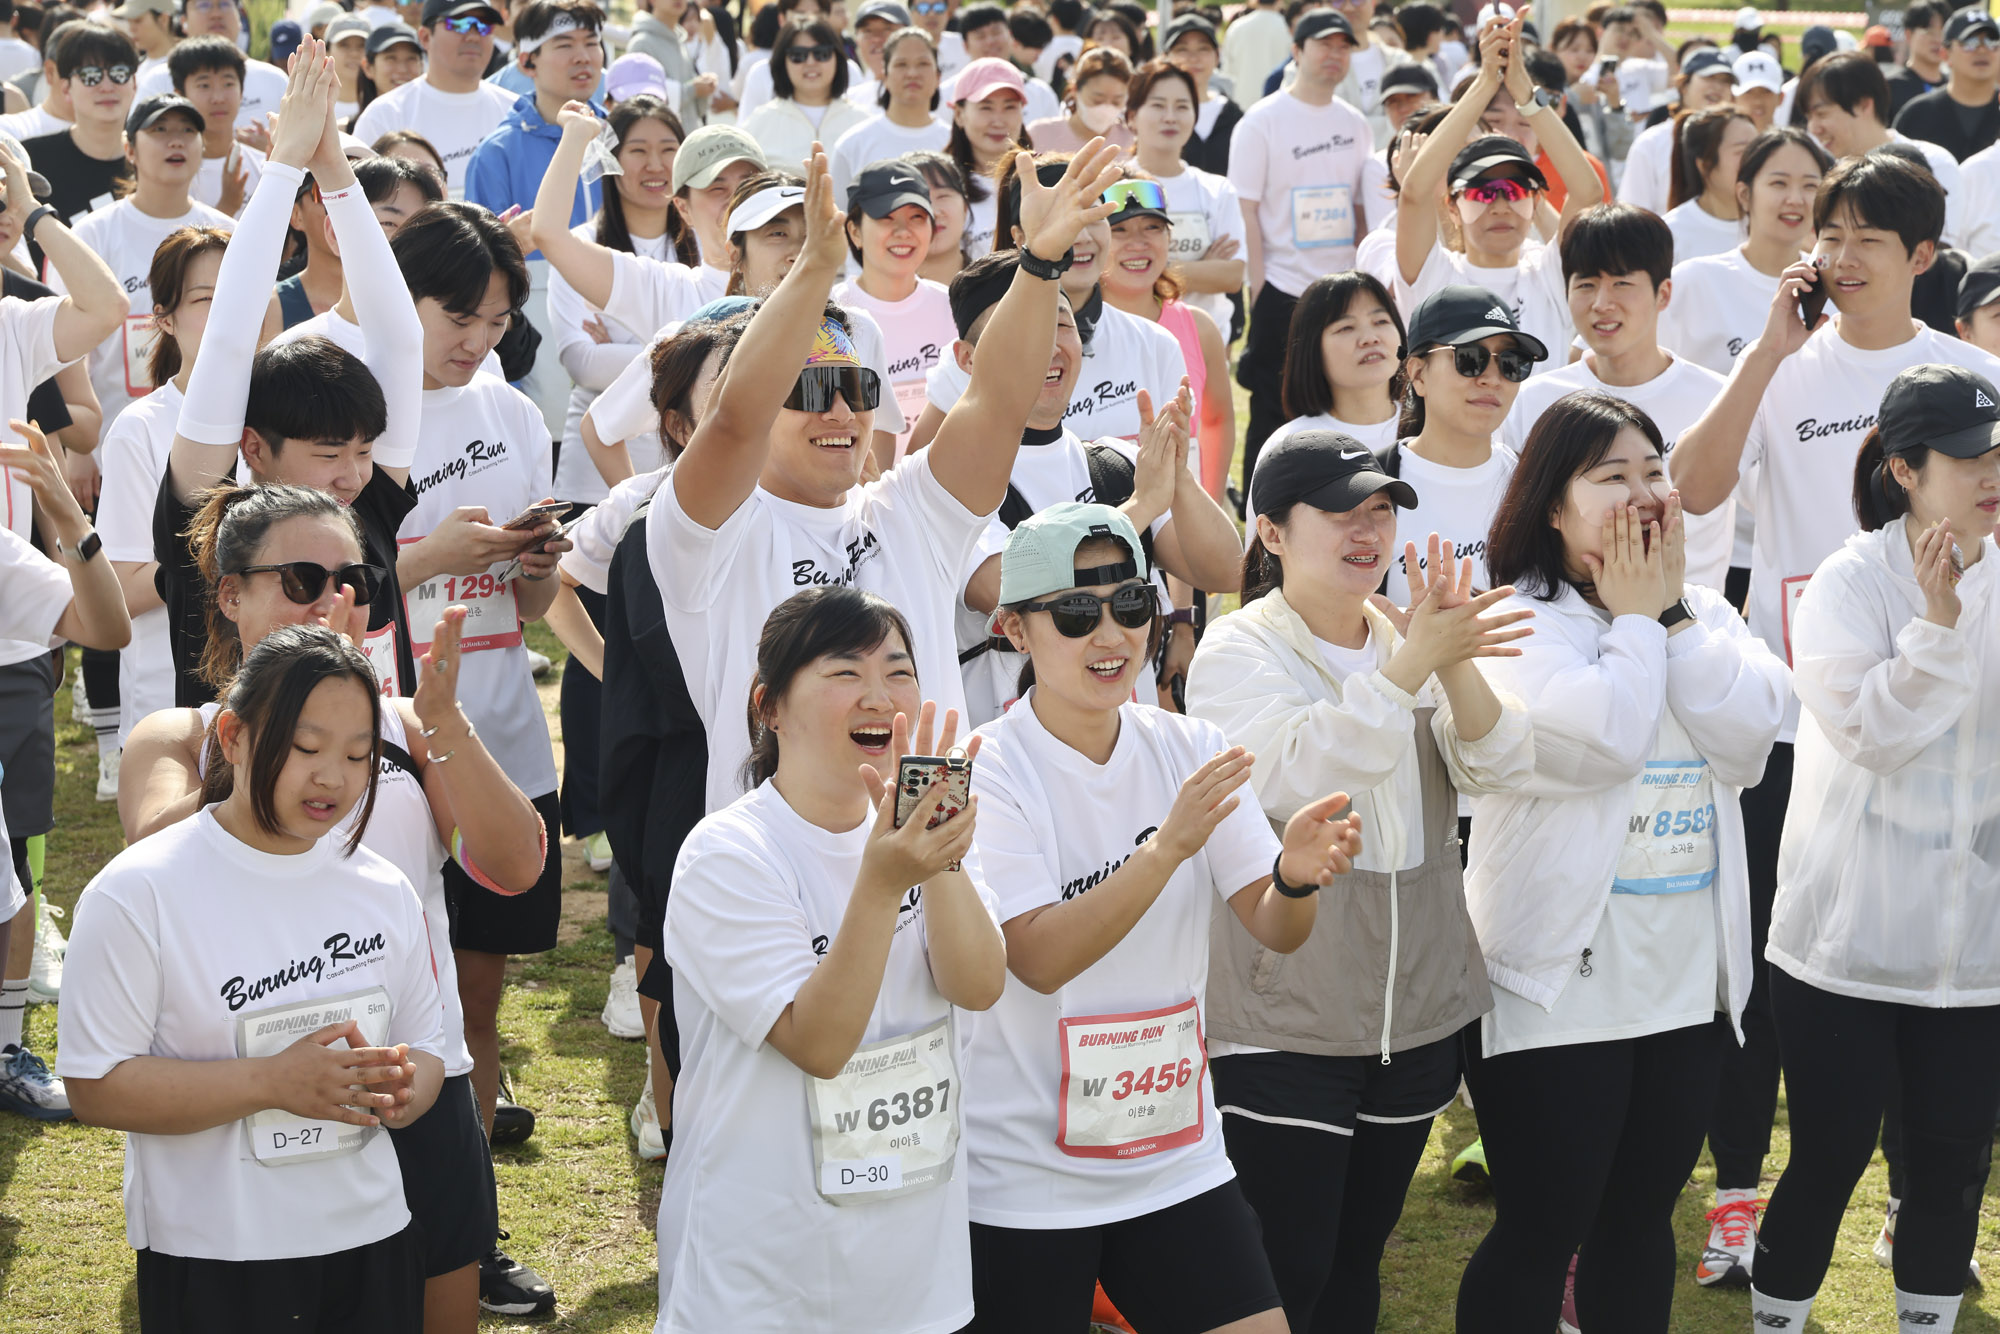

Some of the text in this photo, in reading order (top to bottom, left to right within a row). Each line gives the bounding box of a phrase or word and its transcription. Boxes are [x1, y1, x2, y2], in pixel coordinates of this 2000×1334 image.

[1484, 314, 1511, 325] adidas
[135, 347, 148, 359] W
[1061, 381, 1136, 419] ing Run
[1795, 413, 1880, 442] Burnin
[465, 439, 506, 467] Run
[418, 573, 506, 602] M 1294
[1628, 815, 1651, 833] W
[220, 932, 386, 1012] Burning Run
[325, 954, 386, 981] Casual Running Festival
[367, 1002, 386, 1015] 5km
[255, 1007, 352, 1037] BURNING RUN
[1177, 1018, 1195, 1033] 10km
[928, 1036, 944, 1051] 5km
[1078, 1024, 1166, 1047] BURNING RUN
[1127, 1040, 1146, 1048] Running
[891, 1046, 917, 1065] RUN
[860, 1059, 917, 1078] Casual Running Festival
[1083, 1057, 1192, 1101] W 3456
[834, 1078, 951, 1134] W 6387
[1128, 1104, 1156, 1119] 이한솔
[273, 1127, 323, 1149] D-27
[840, 1165, 889, 1185] D-30
